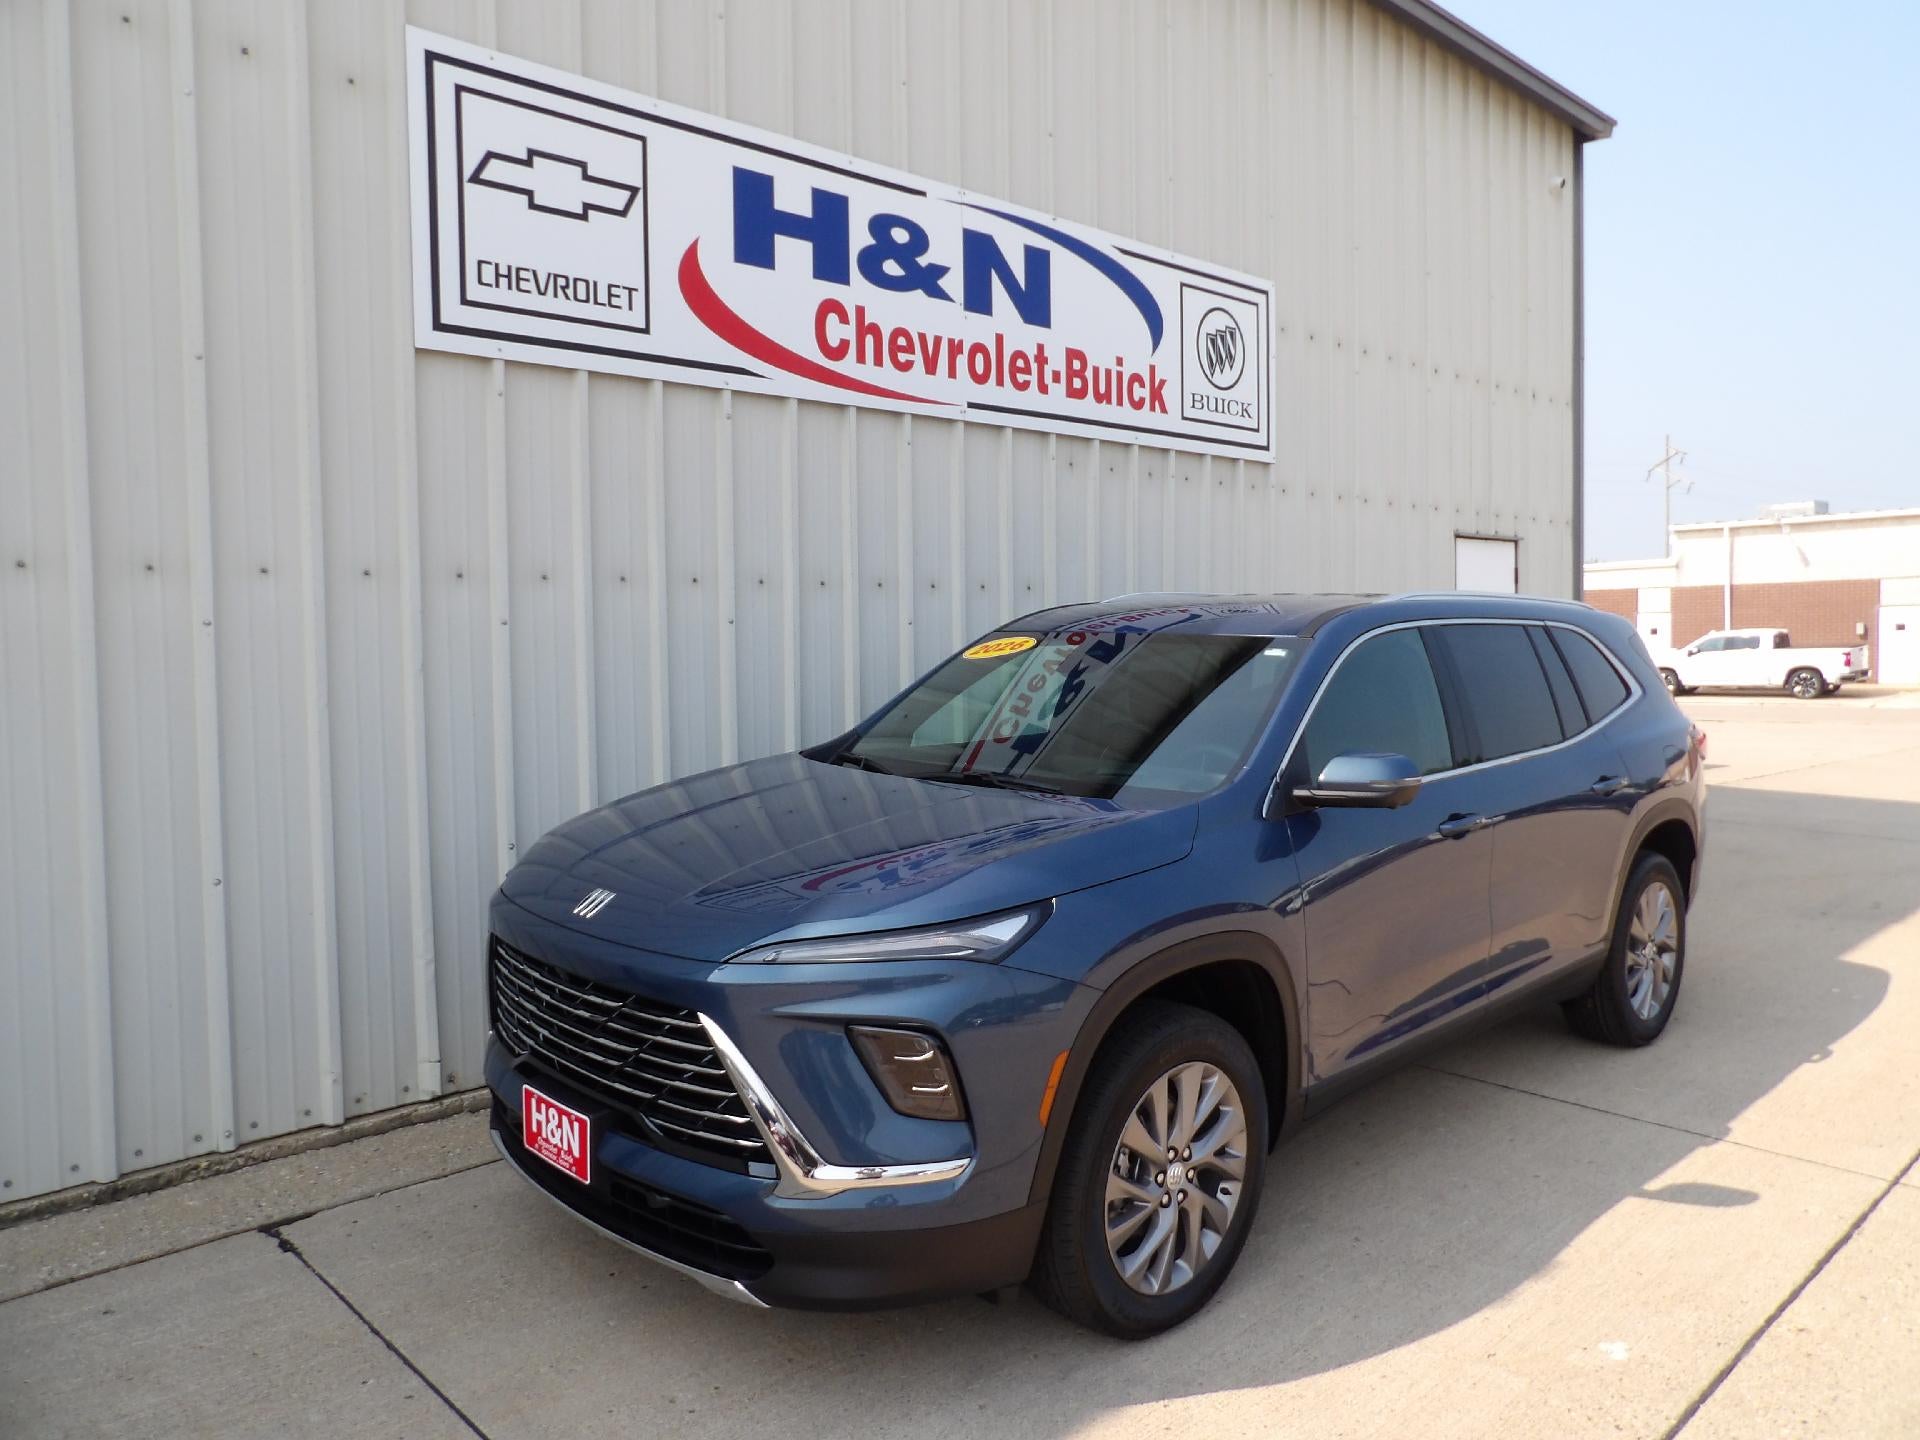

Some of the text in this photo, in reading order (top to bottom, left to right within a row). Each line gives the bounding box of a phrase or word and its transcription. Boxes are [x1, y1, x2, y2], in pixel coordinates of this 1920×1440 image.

[733, 165, 1051, 329] H&N
[476, 259, 639, 311] CHEVROLET
[814, 298, 1168, 414] Chevrolet-Buick
[1190, 392, 1254, 419] BUICK
[968, 639, 1030, 656] 2026
[531, 1097, 580, 1158] H&N
